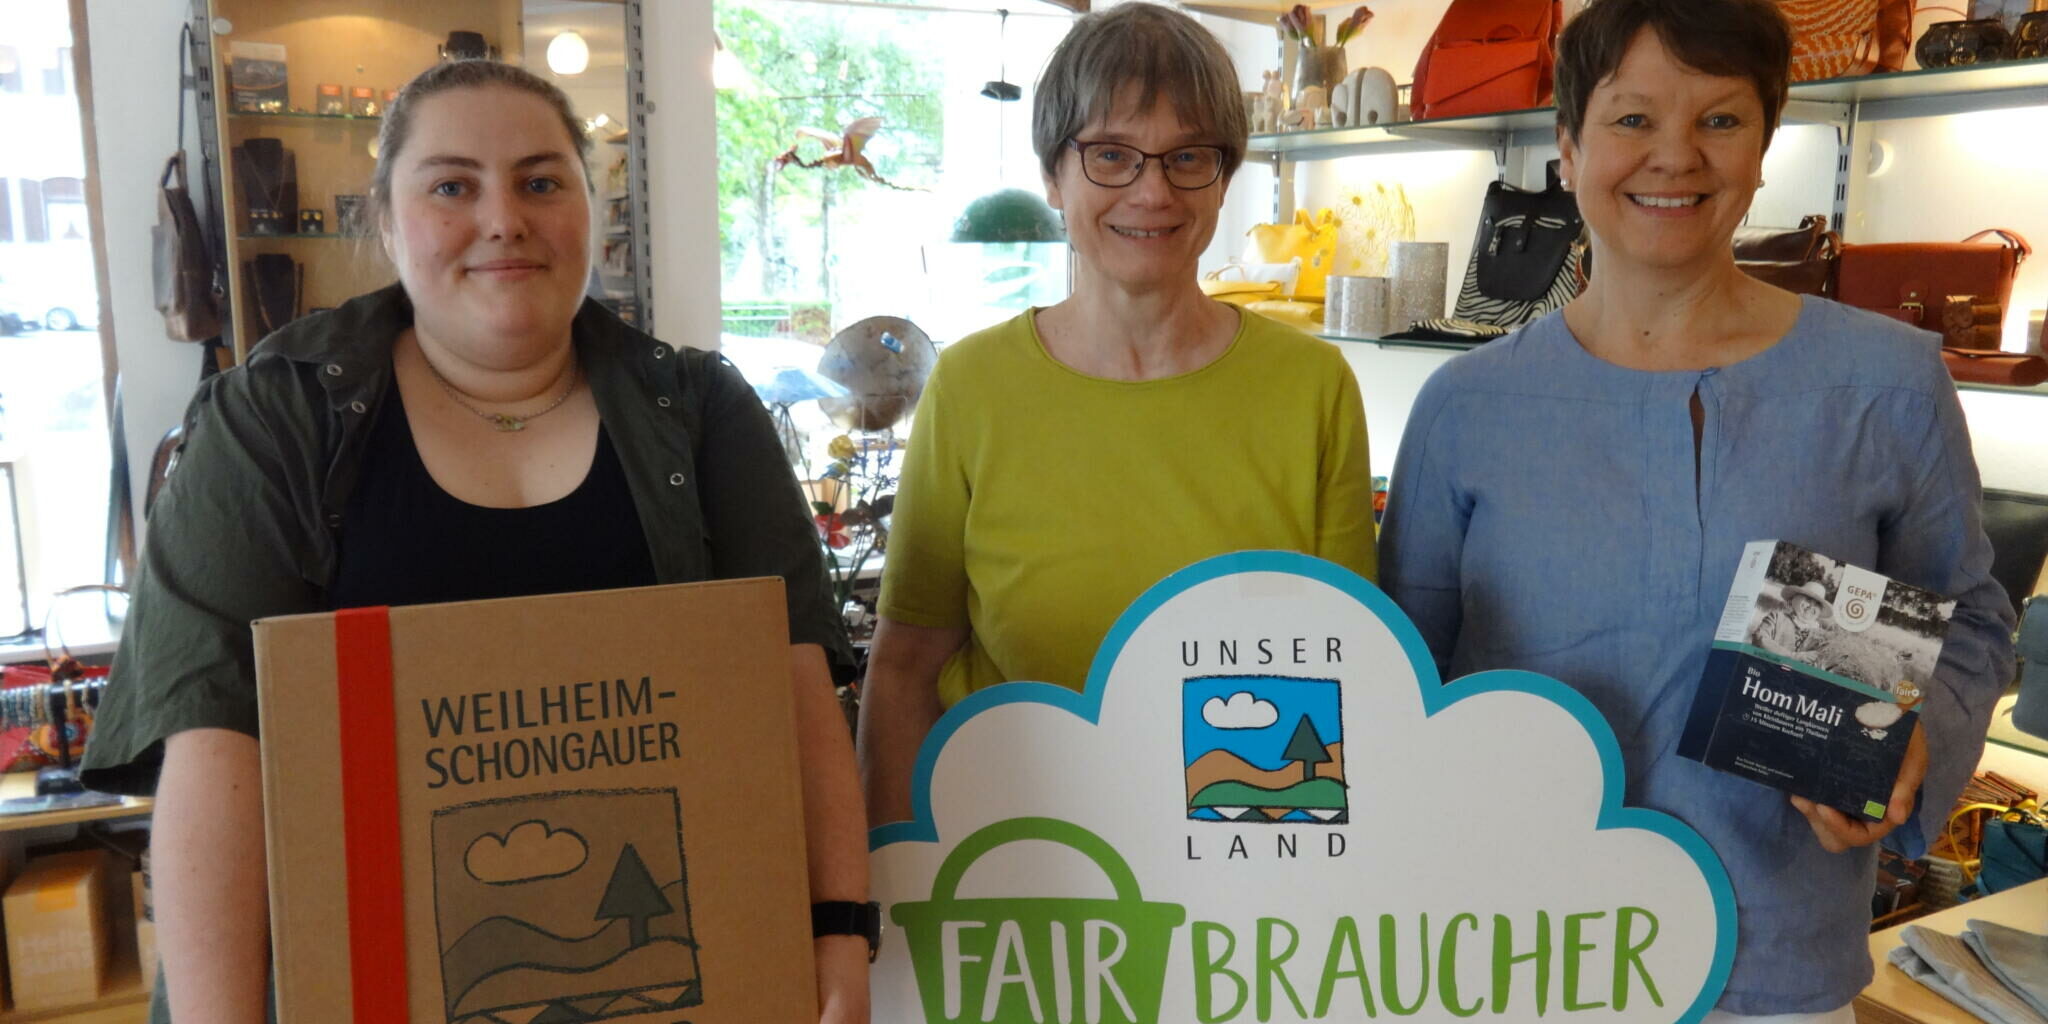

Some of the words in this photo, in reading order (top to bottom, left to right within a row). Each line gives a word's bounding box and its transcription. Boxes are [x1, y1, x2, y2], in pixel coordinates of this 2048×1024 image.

[1182, 637, 1342, 666] UNSER
[1747, 666, 1761, 677] Bio
[421, 676, 676, 738] WEILHEIM-
[1742, 676, 1793, 710] Hom
[1795, 694, 1843, 727] Mali
[426, 722, 680, 789] SCHONGAUER
[1187, 833, 1346, 860] LAND
[941, 919, 1137, 1024] FAIR
[1191, 906, 1664, 1024] BRAUCHER
